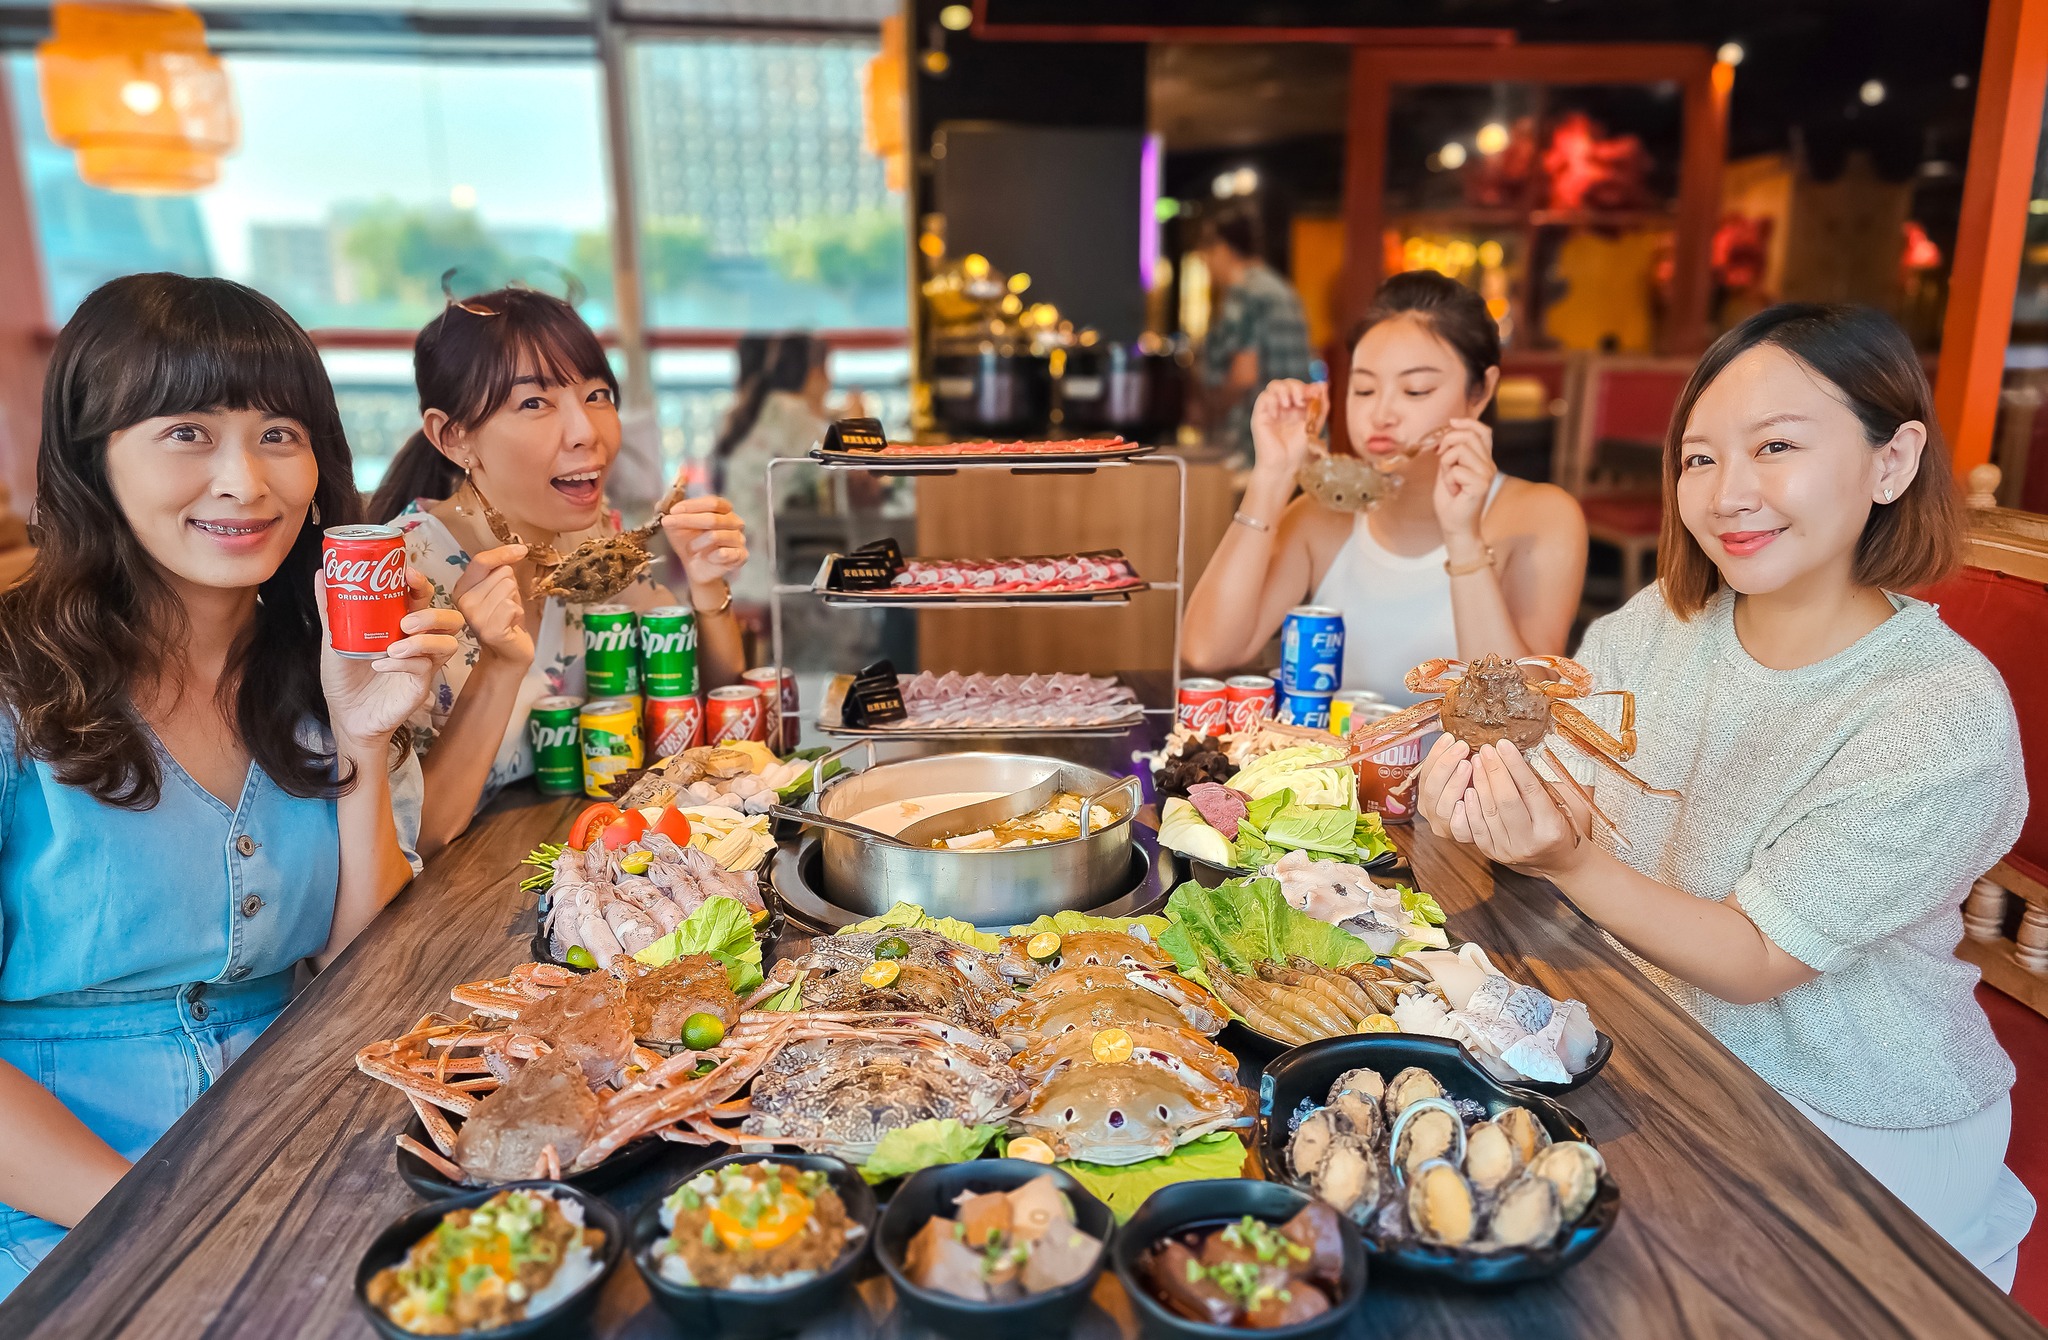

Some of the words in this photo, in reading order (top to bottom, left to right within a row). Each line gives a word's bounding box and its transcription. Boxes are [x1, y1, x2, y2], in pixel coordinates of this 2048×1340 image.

[323, 547, 407, 592] Coca-Col
[338, 593, 381, 601] ORIGINAL
[383, 590, 404, 600] TASTE
[641, 623, 698, 659] Sprit
